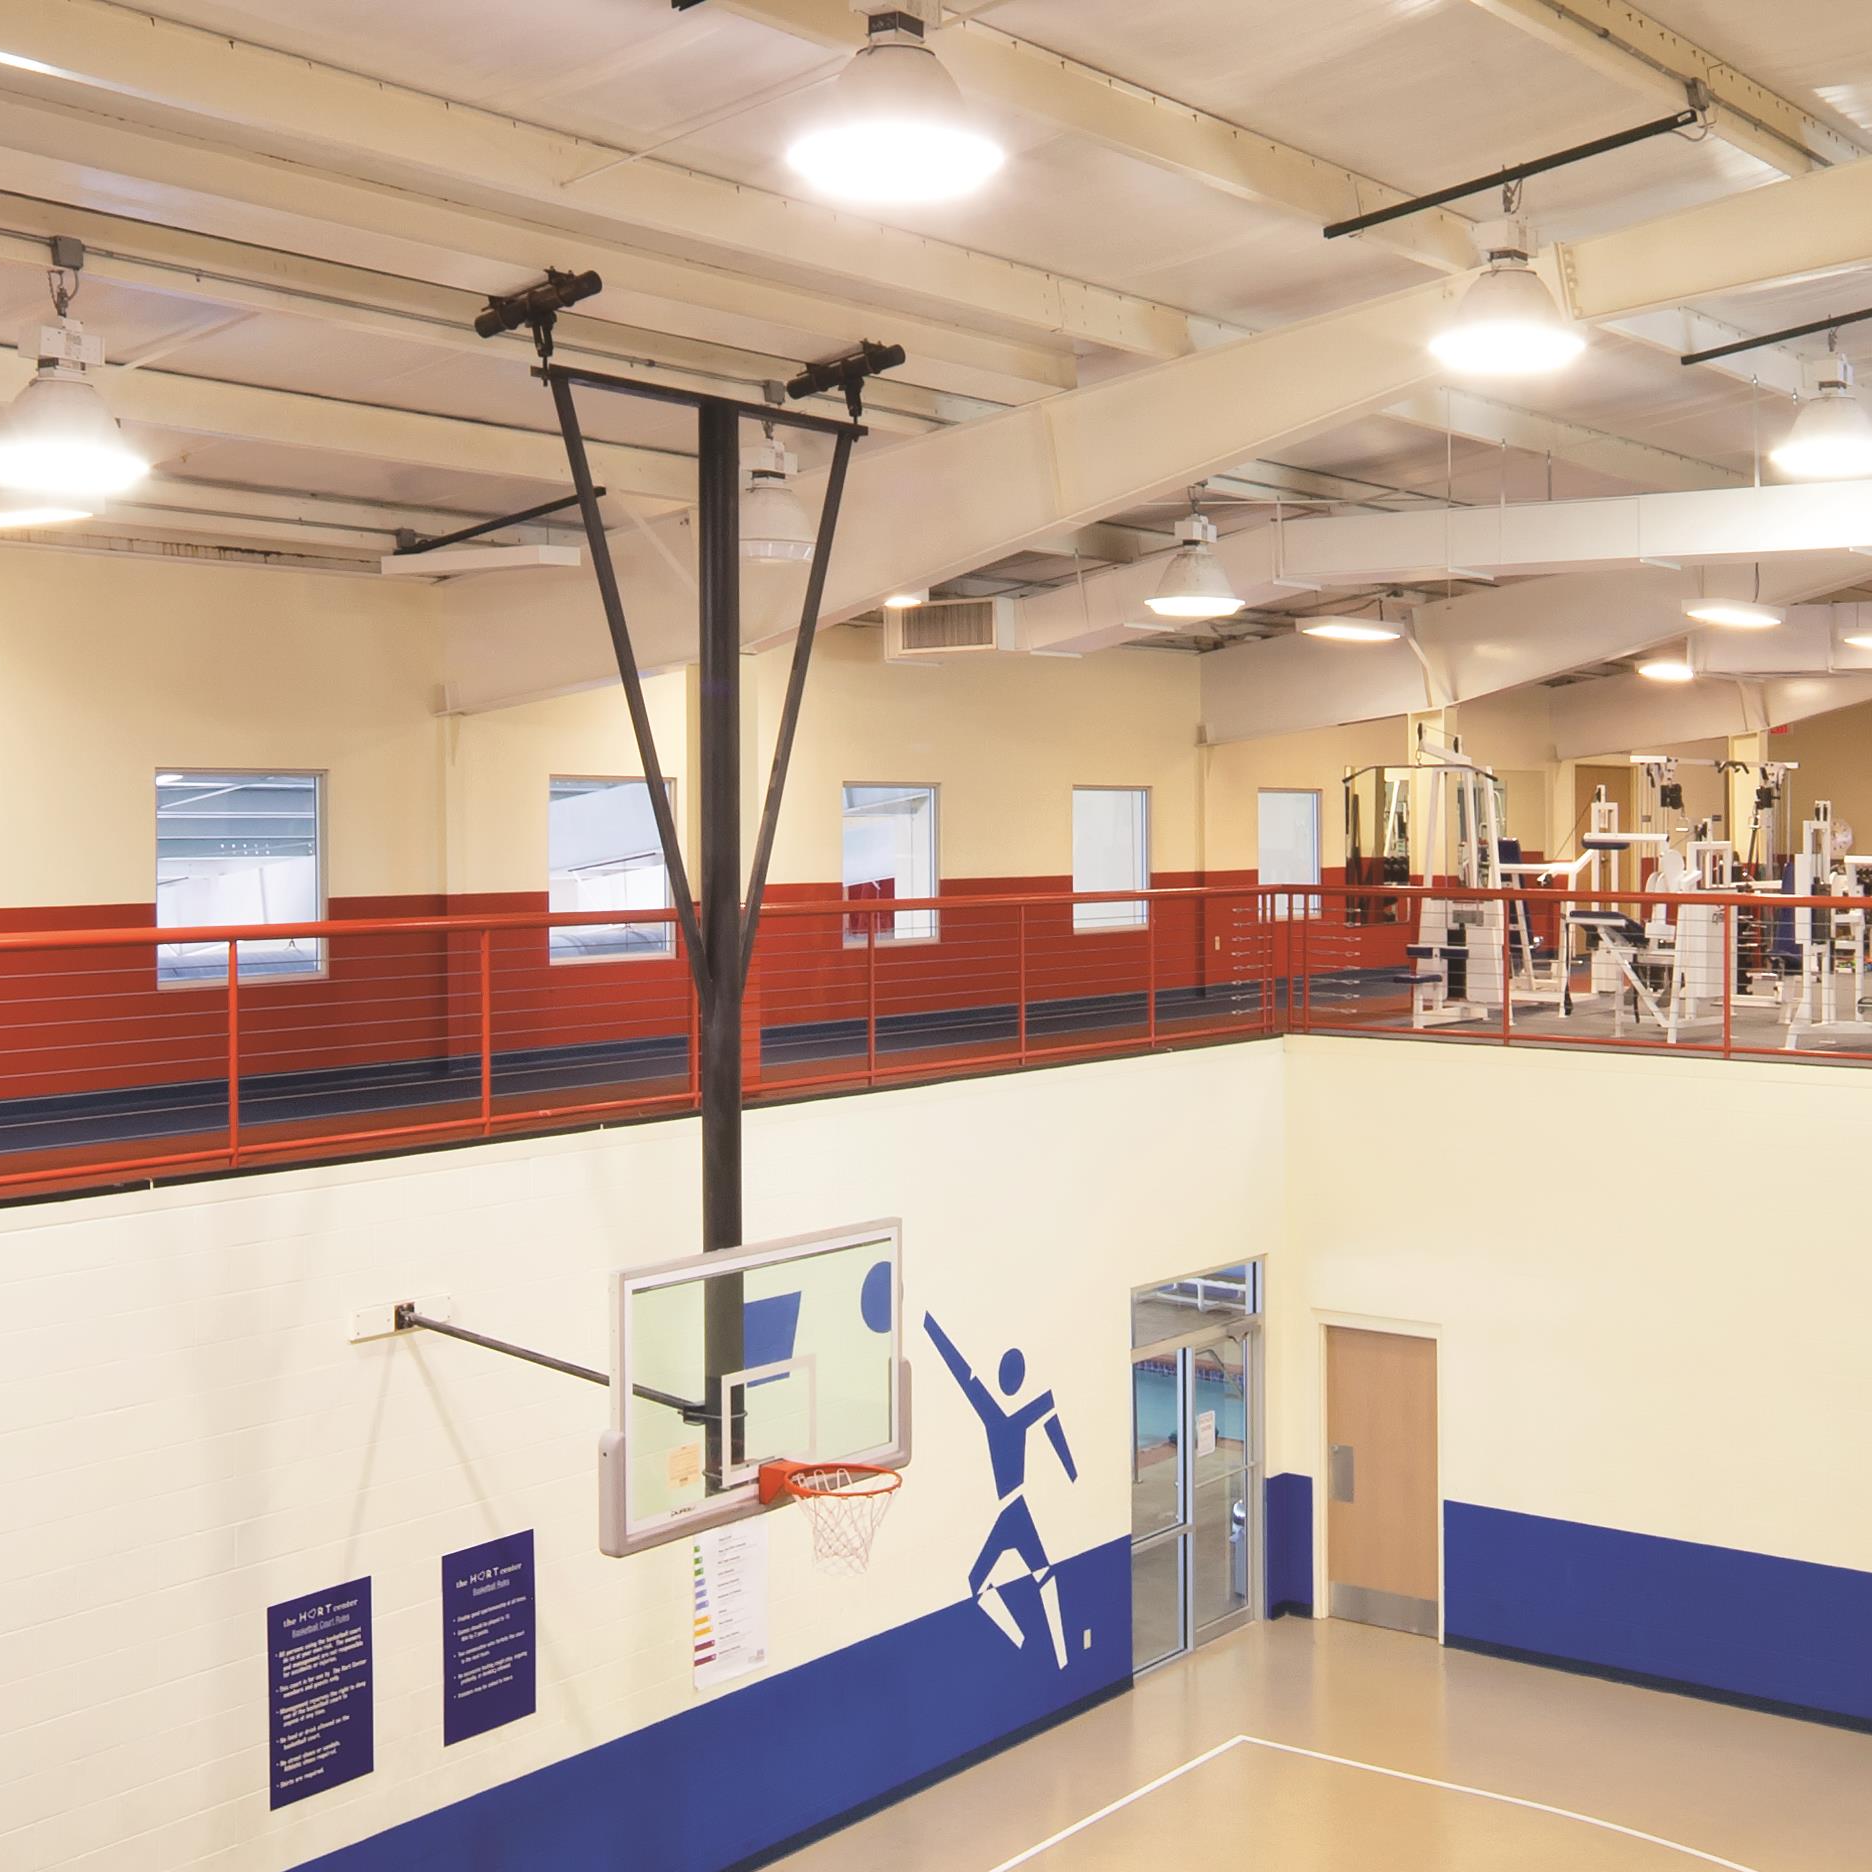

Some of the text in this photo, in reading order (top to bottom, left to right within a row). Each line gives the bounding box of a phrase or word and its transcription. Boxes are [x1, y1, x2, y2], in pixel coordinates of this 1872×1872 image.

[456, 1580, 468, 1588] the
[500, 1563, 522, 1574] center
[283, 1600, 358, 1627] the HORT center
[292, 1623, 318, 1639] Basketball
